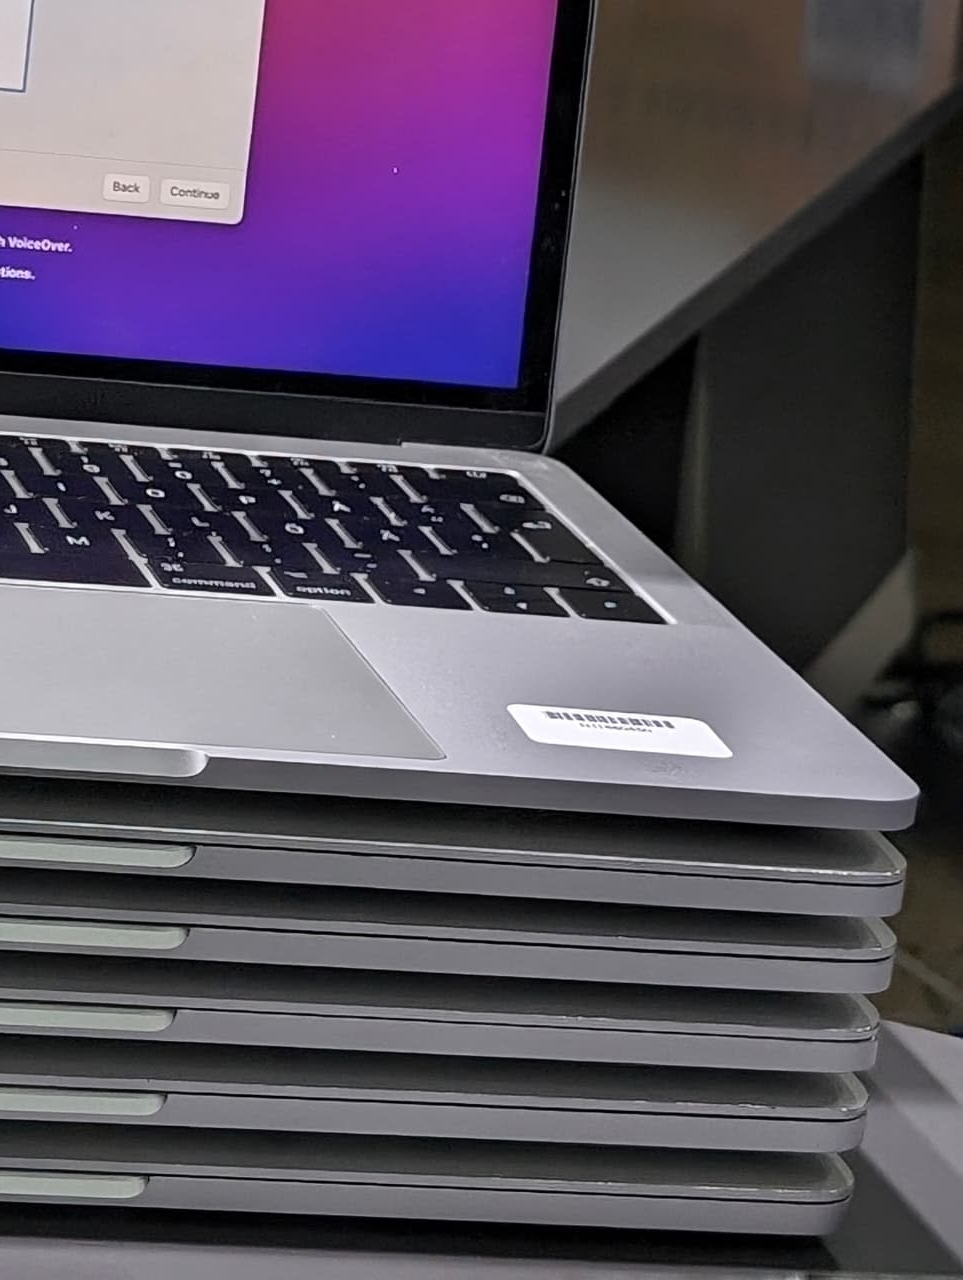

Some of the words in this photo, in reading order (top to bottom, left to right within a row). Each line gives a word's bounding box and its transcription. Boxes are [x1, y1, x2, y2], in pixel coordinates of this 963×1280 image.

[112, 181, 140, 194] Back
[170, 186, 220, 200] Continue
[8, 236, 73, 253] VoiceOver.
